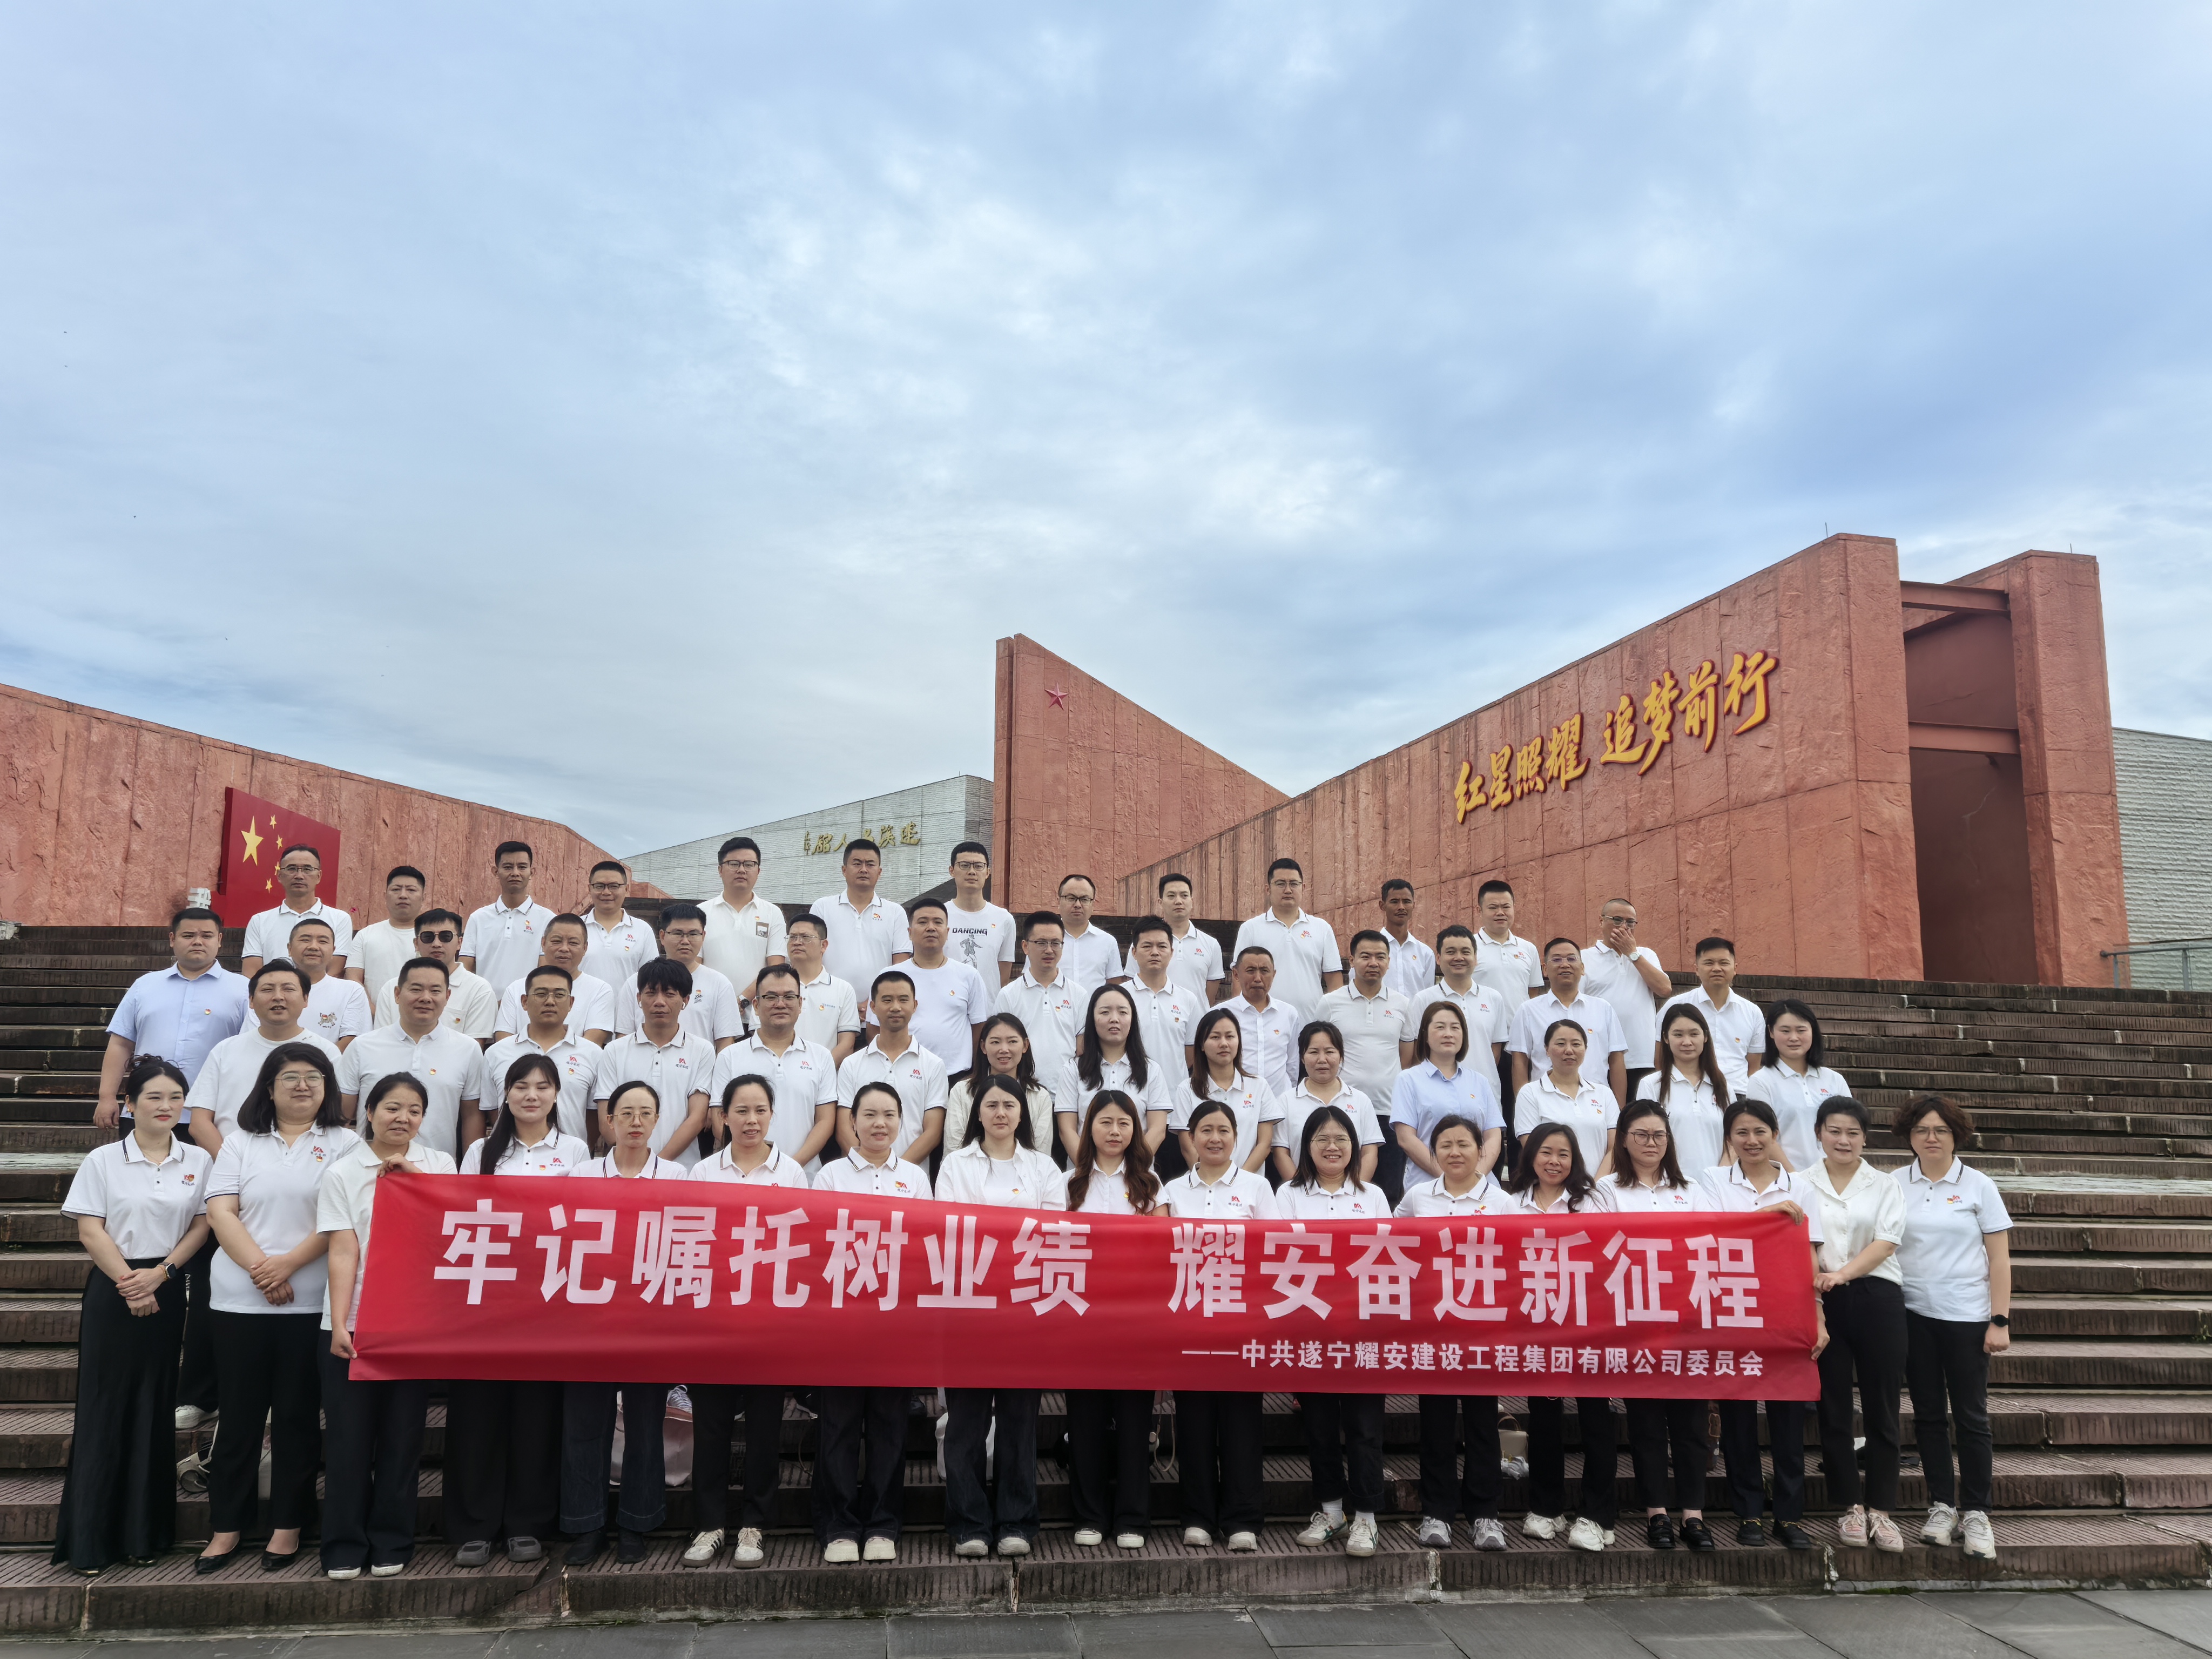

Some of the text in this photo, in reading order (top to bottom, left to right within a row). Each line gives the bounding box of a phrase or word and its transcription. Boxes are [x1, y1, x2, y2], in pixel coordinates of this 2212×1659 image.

[1454, 650, 1779, 824] 红星照耀 追梦前行
[434, 1198, 1763, 1329] 牢记嘱托树业绩 耀安奋进新征程
